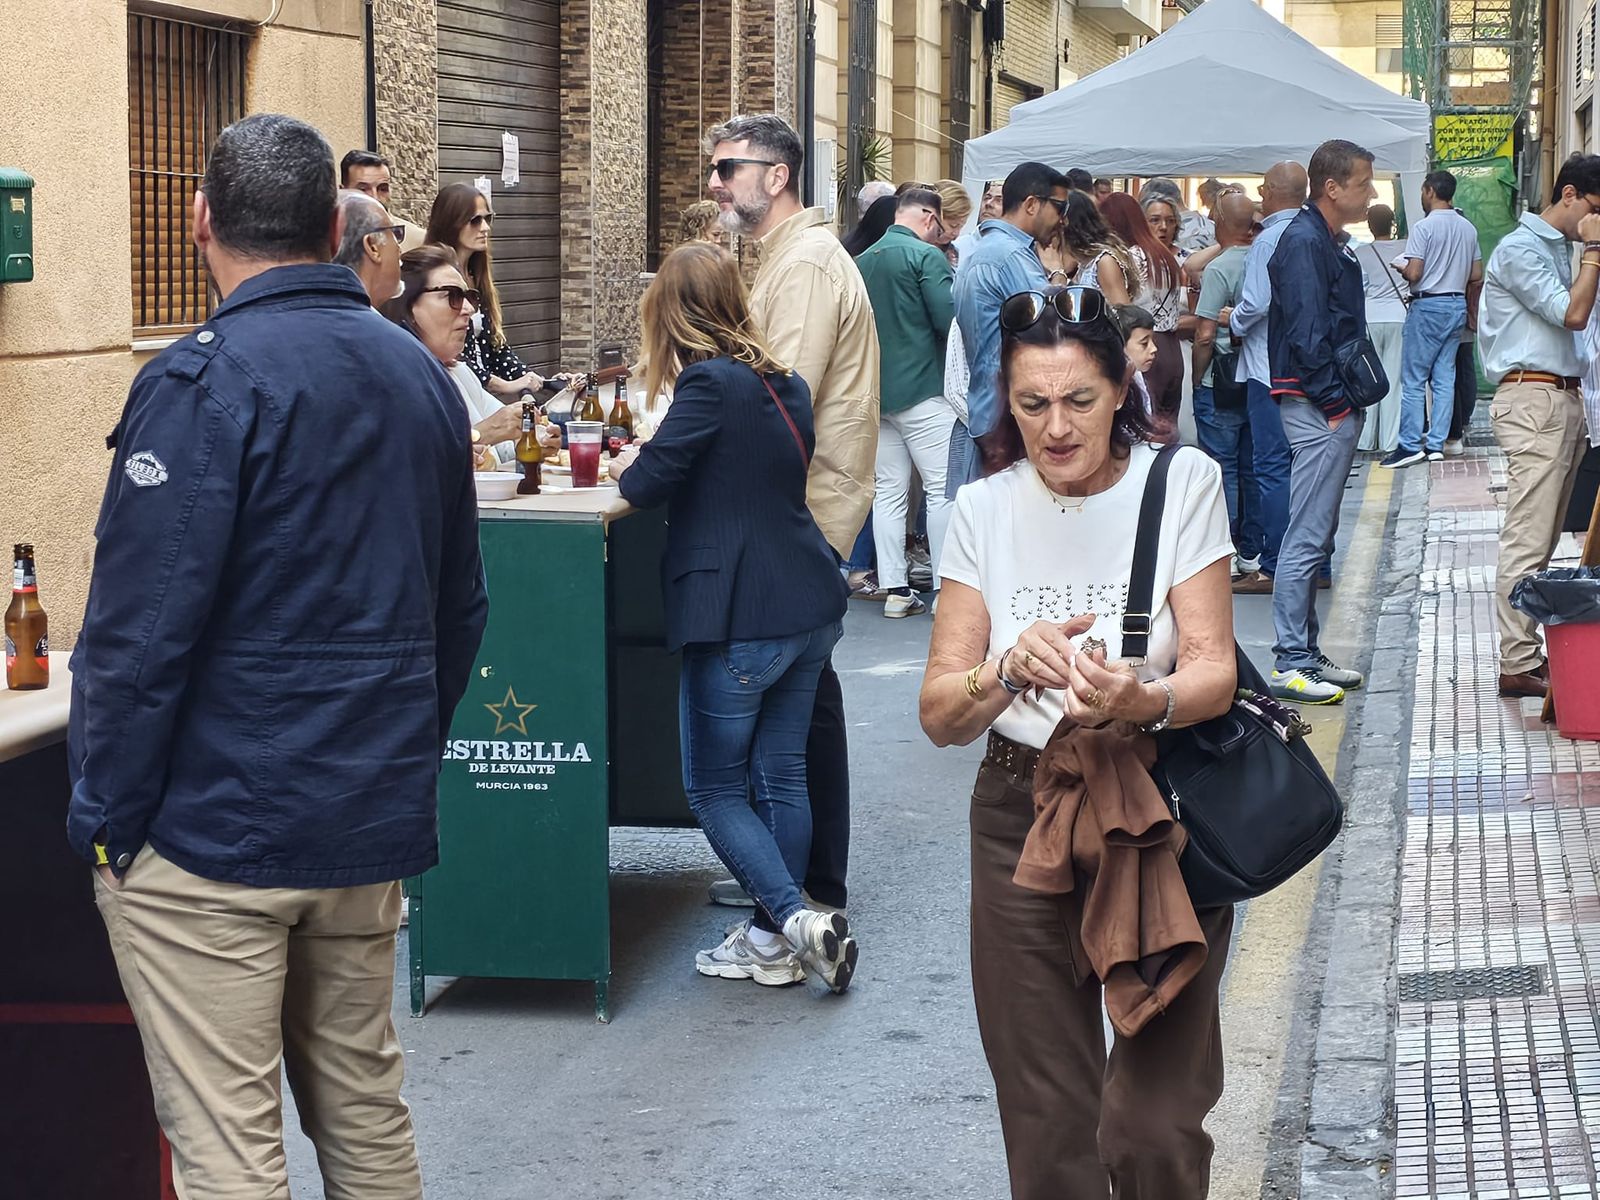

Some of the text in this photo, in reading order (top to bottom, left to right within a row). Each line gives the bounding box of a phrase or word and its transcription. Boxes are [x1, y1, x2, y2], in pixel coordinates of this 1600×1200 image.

[468, 762, 556, 775] DE LEVANTE
[476, 782, 521, 790] MURCIA
